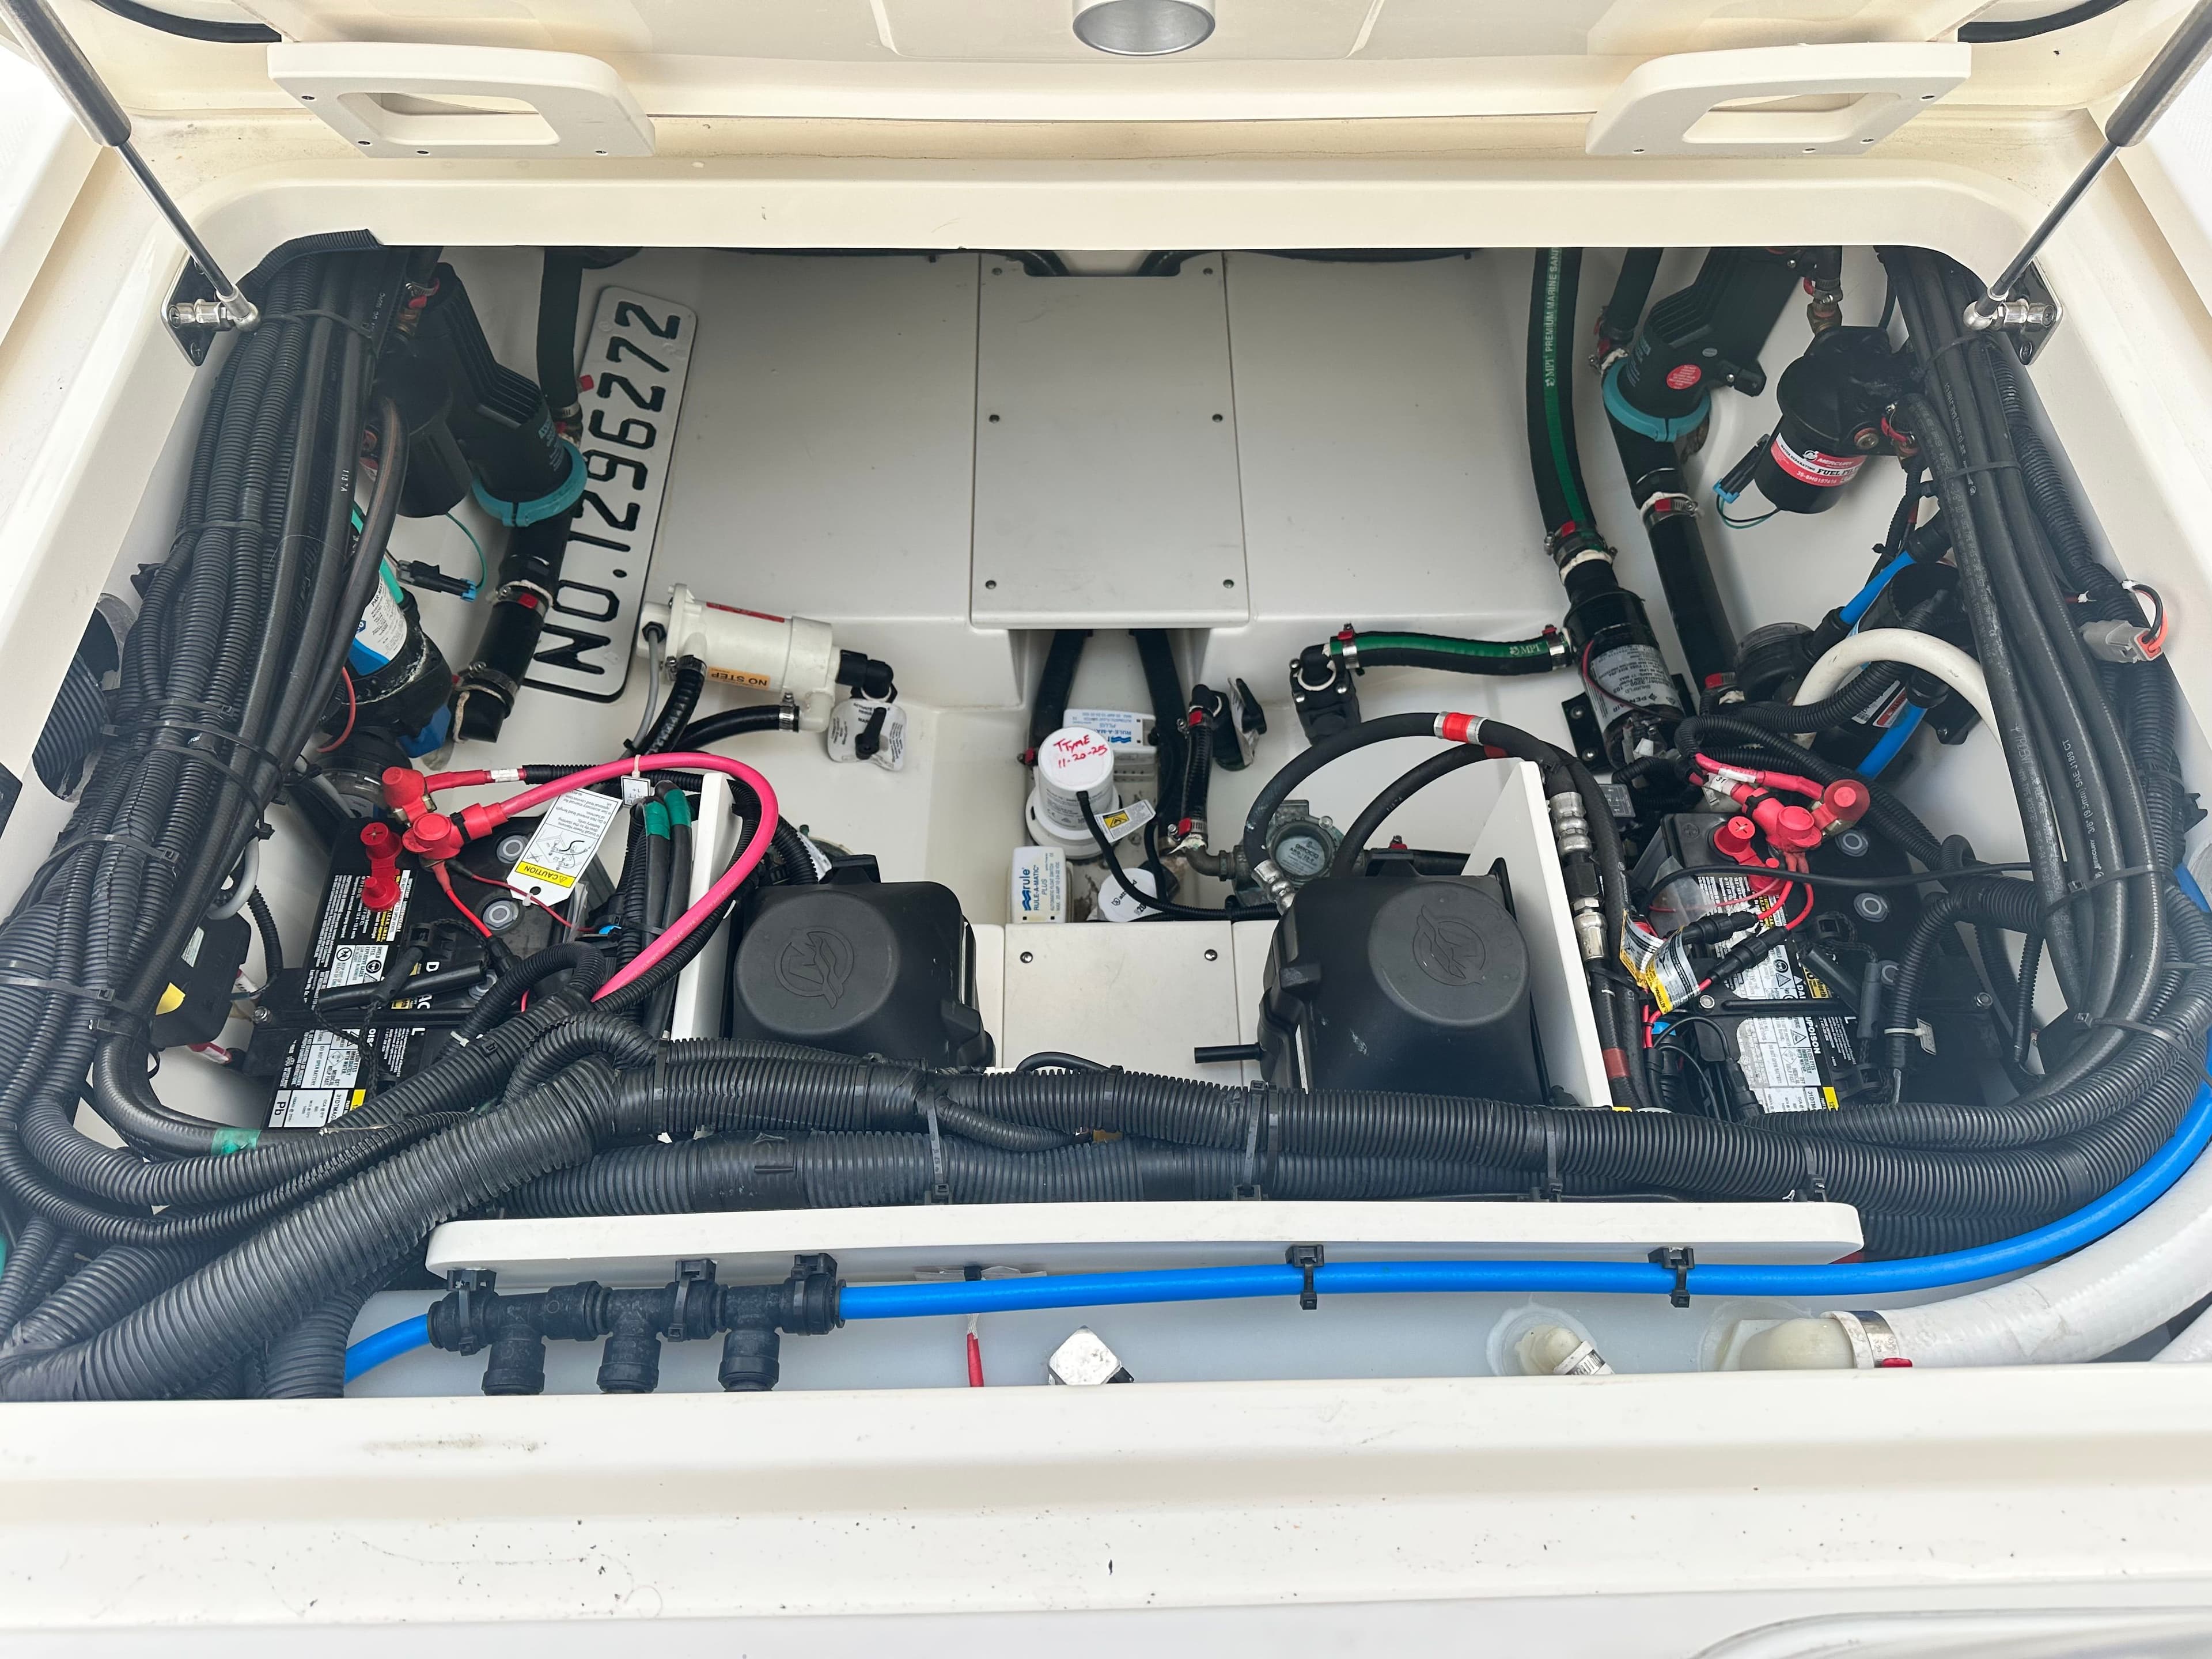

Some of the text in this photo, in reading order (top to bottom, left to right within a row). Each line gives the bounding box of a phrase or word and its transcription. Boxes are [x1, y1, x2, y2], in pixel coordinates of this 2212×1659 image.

[1547, 274, 1556, 309] MARINE
[1544, 311, 1554, 351] PREMIUM
[1545, 359, 1554, 376] MPI
[1780, 444, 1790, 457] WATER
[1790, 454, 1815, 471] SEPARATING
[1520, 643, 1540, 654] MPI
[711, 671, 767, 687] NO STEP
[2071, 770, 2084, 788] SAE
[521, 865, 560, 880] CAUTION
[1018, 868, 1030, 889] rule
[361, 946, 370, 964] EXPLOSIVE
[343, 1050, 351, 1060] WITH
[345, 1050, 357, 1075] IMMEDIATELY
[1801, 1048, 1812, 1073] IMMEDIATELY
[325, 1065, 333, 1075] HELP
[351, 1062, 359, 1073] EYES
[327, 1069, 338, 1086] MEDICAL
[273, 1101, 286, 1116] Pb
